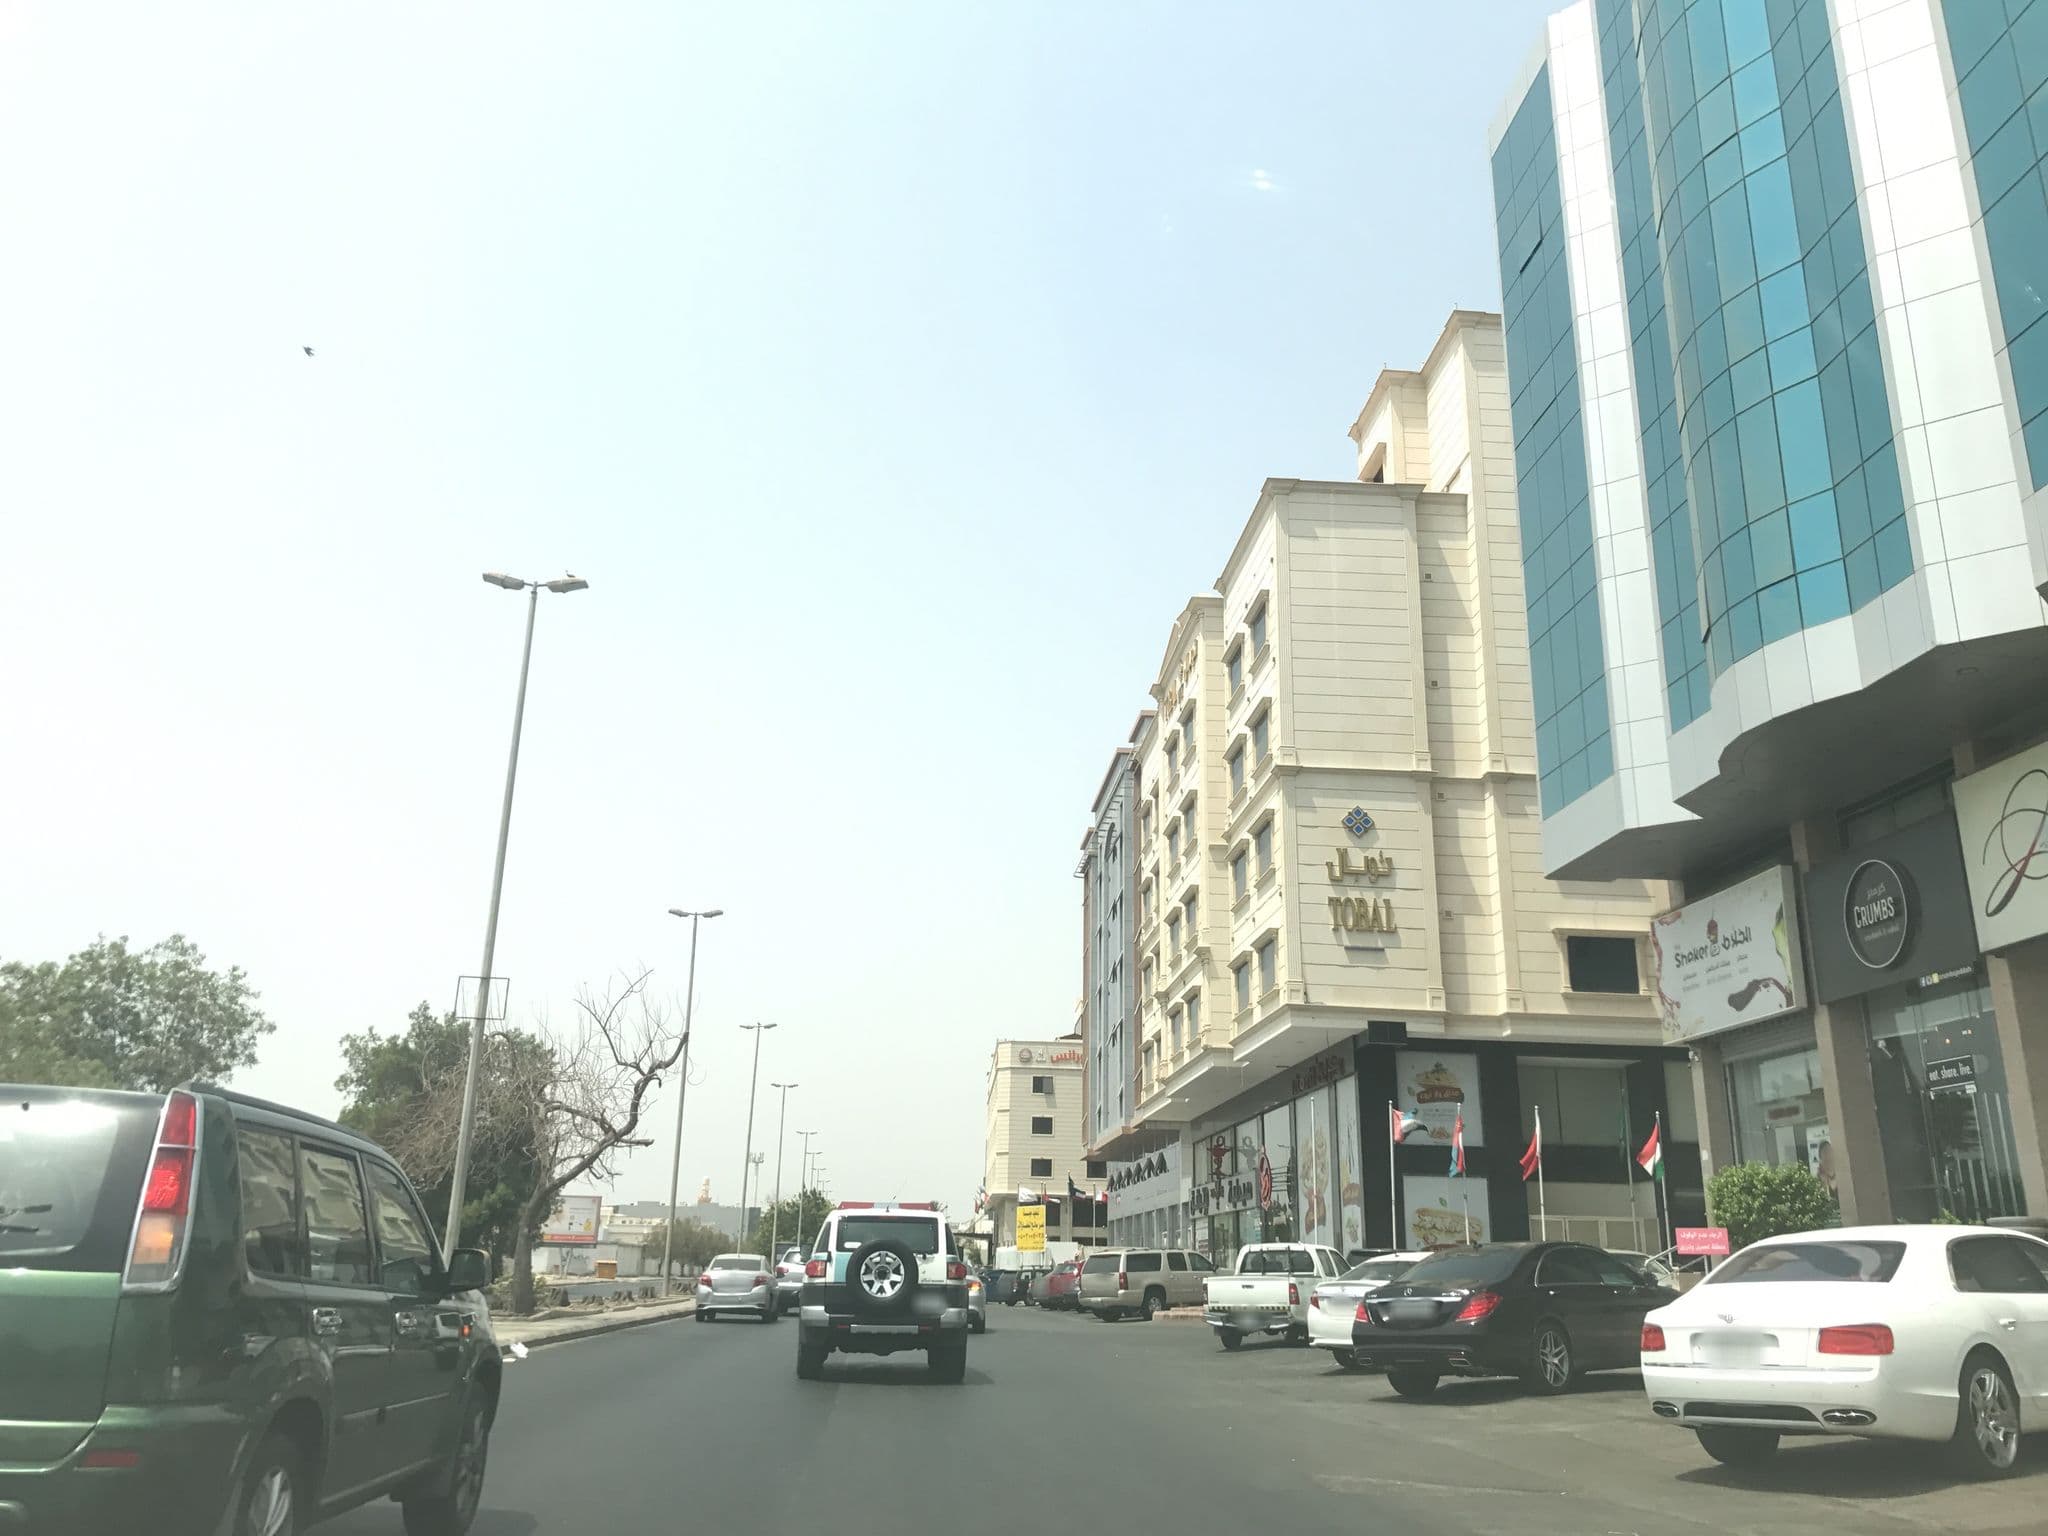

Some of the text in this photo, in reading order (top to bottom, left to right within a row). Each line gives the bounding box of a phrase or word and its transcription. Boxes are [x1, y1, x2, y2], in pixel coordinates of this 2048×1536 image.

[1328, 896, 1397, 933] TOBAL
[1854, 896, 1895, 929] CRUMBS
[1674, 944, 1708, 968] Shaker
[1929, 1062, 1973, 1081] eat. share. live.
